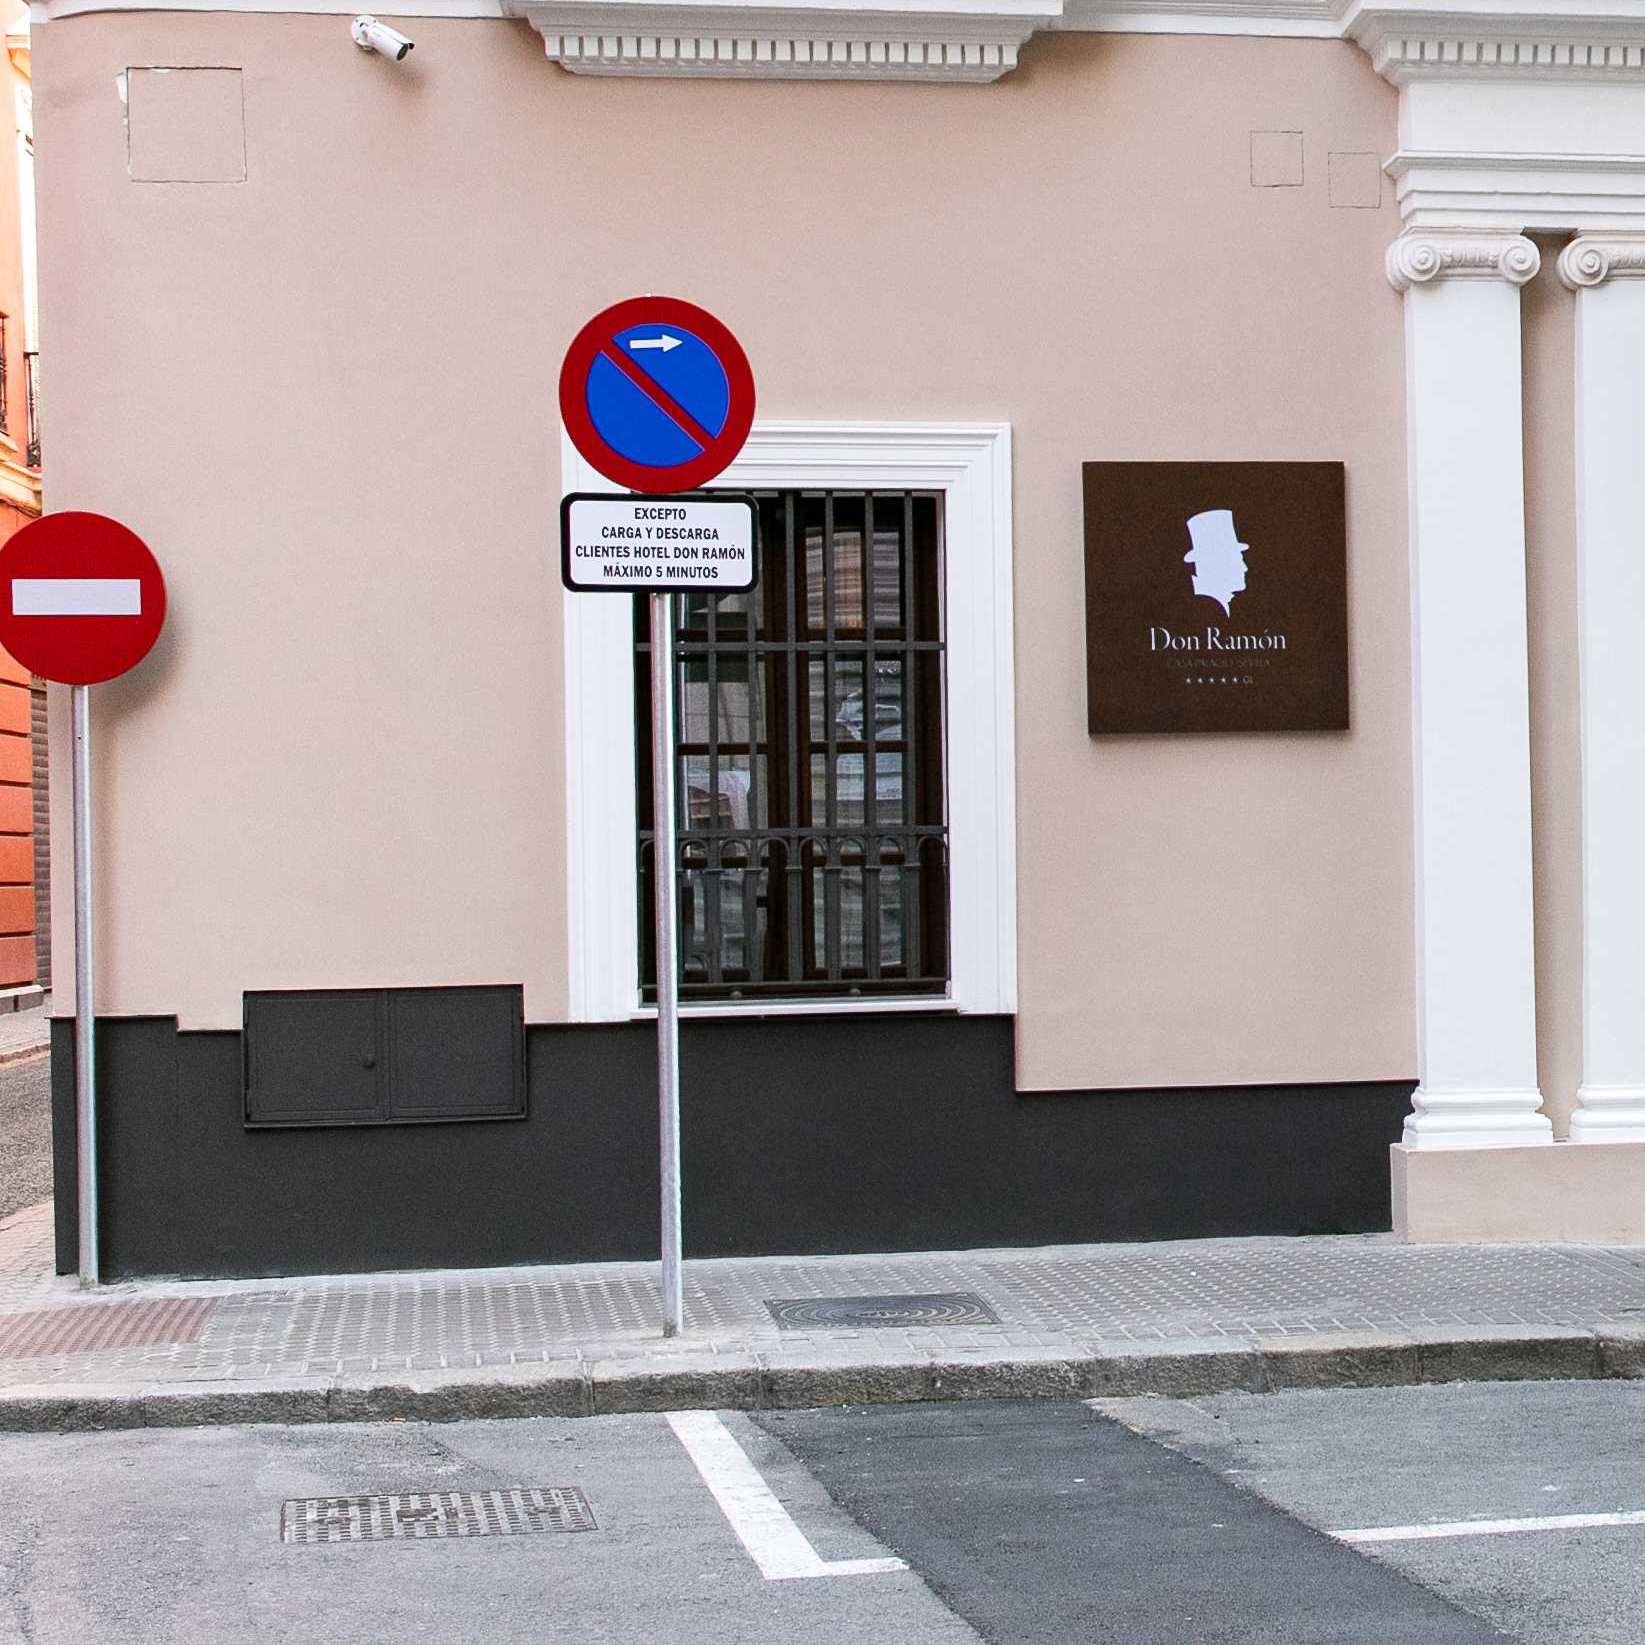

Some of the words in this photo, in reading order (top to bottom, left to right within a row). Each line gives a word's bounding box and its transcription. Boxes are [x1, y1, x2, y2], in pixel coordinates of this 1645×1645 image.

[635, 507, 687, 520] EXCEPTO
[602, 527, 642, 539] CARGA
[646, 527, 653, 538] Y
[657, 527, 719, 540] DESCARGA
[575, 545, 631, 558] CLIENTES
[634, 546, 671, 558] HOTEL
[673, 546, 699, 559] DON
[702, 544, 745, 560] RAMÓN
[603, 562, 653, 578] MÁXIMO
[656, 566, 663, 578] 5
[666, 566, 718, 578] MINUTOS
[1150, 627, 1200, 651] Don
[1207, 627, 1286, 650] Ramón
